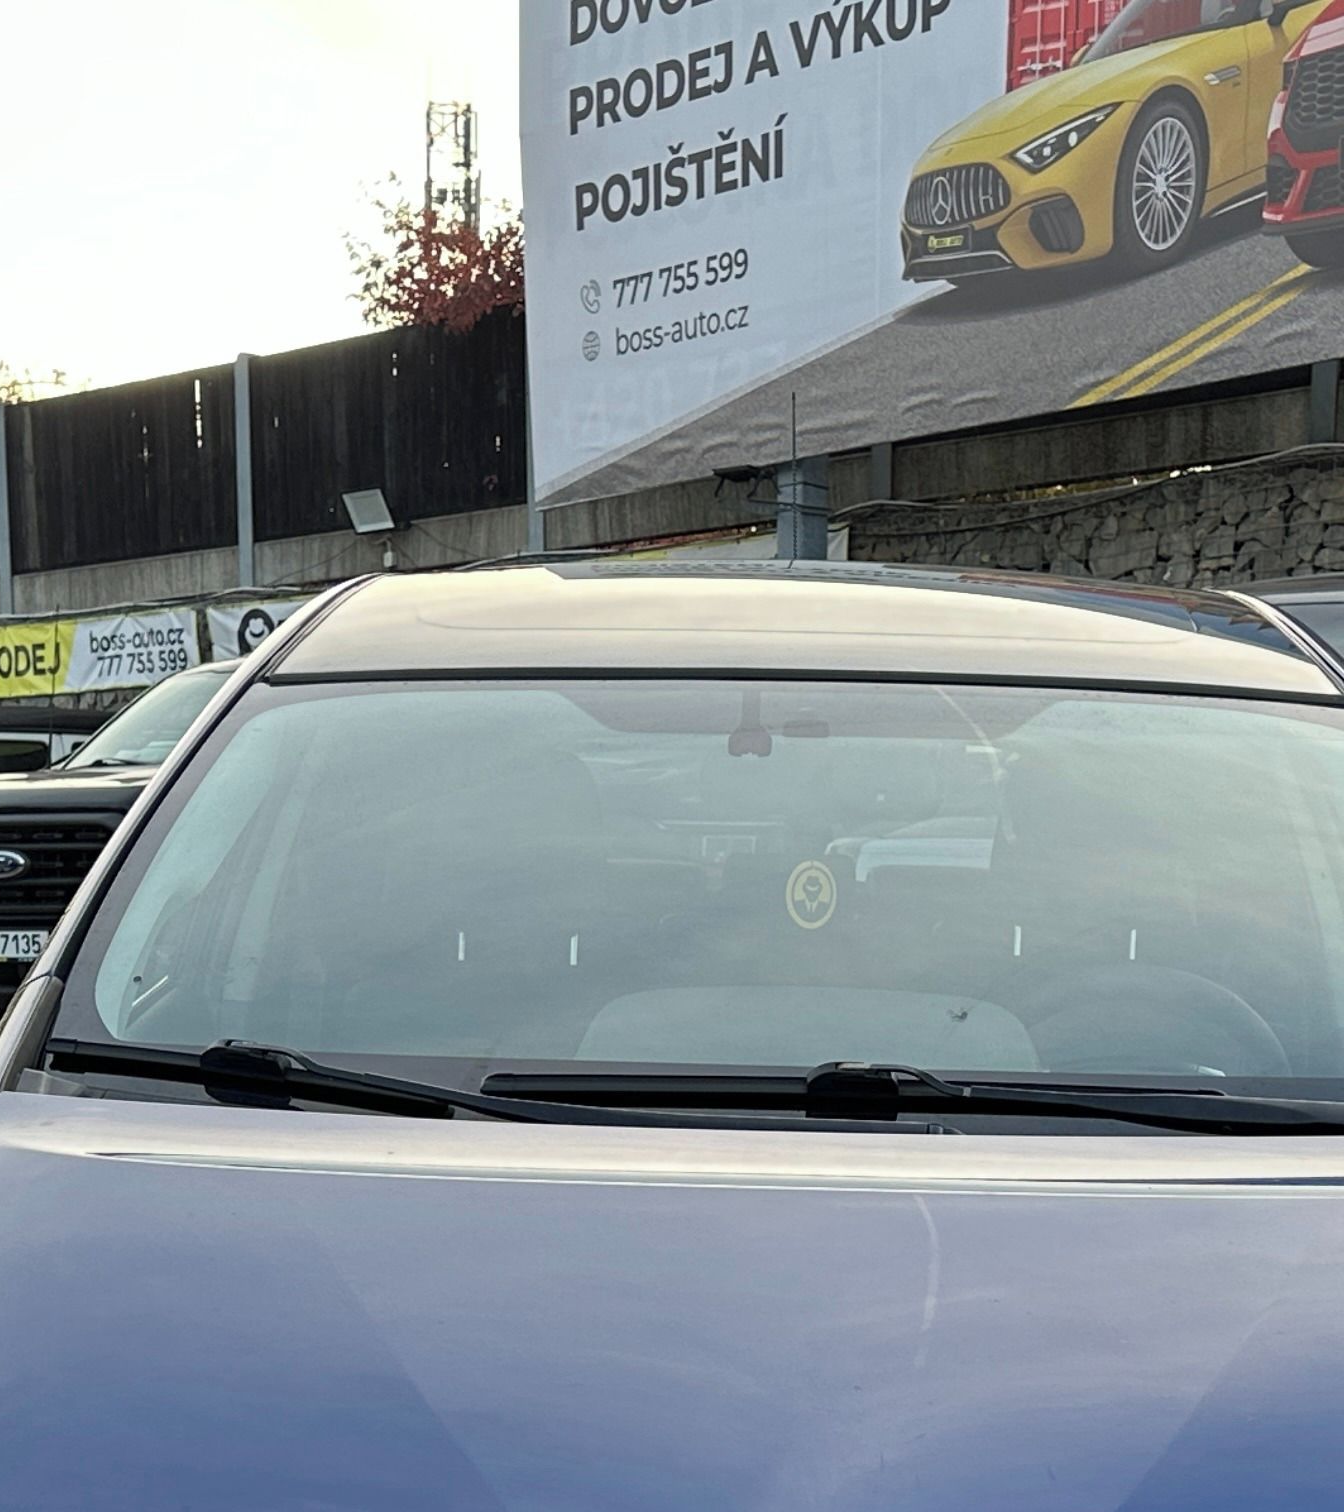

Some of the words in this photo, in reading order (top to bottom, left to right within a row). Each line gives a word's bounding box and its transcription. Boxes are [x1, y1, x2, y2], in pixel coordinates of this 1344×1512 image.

[570, 0, 712, 46] DOV
[569, 40, 734, 135] PRODEJ
[744, 30, 780, 85] A
[788, 0, 950, 69] VÝKUP
[575, 112, 789, 231] POJIŠTĚNÍ
[612, 271, 654, 308] 777
[659, 260, 699, 297] 755
[704, 248, 749, 286] 599
[616, 305, 749, 356] boss-auto.cz
[89, 627, 184, 653] boss-auto.cz
[97, 655, 125, 678] 777
[128, 651, 155, 675] 755
[158, 647, 188, 672] 599
[0, 934, 42, 954] 7135
